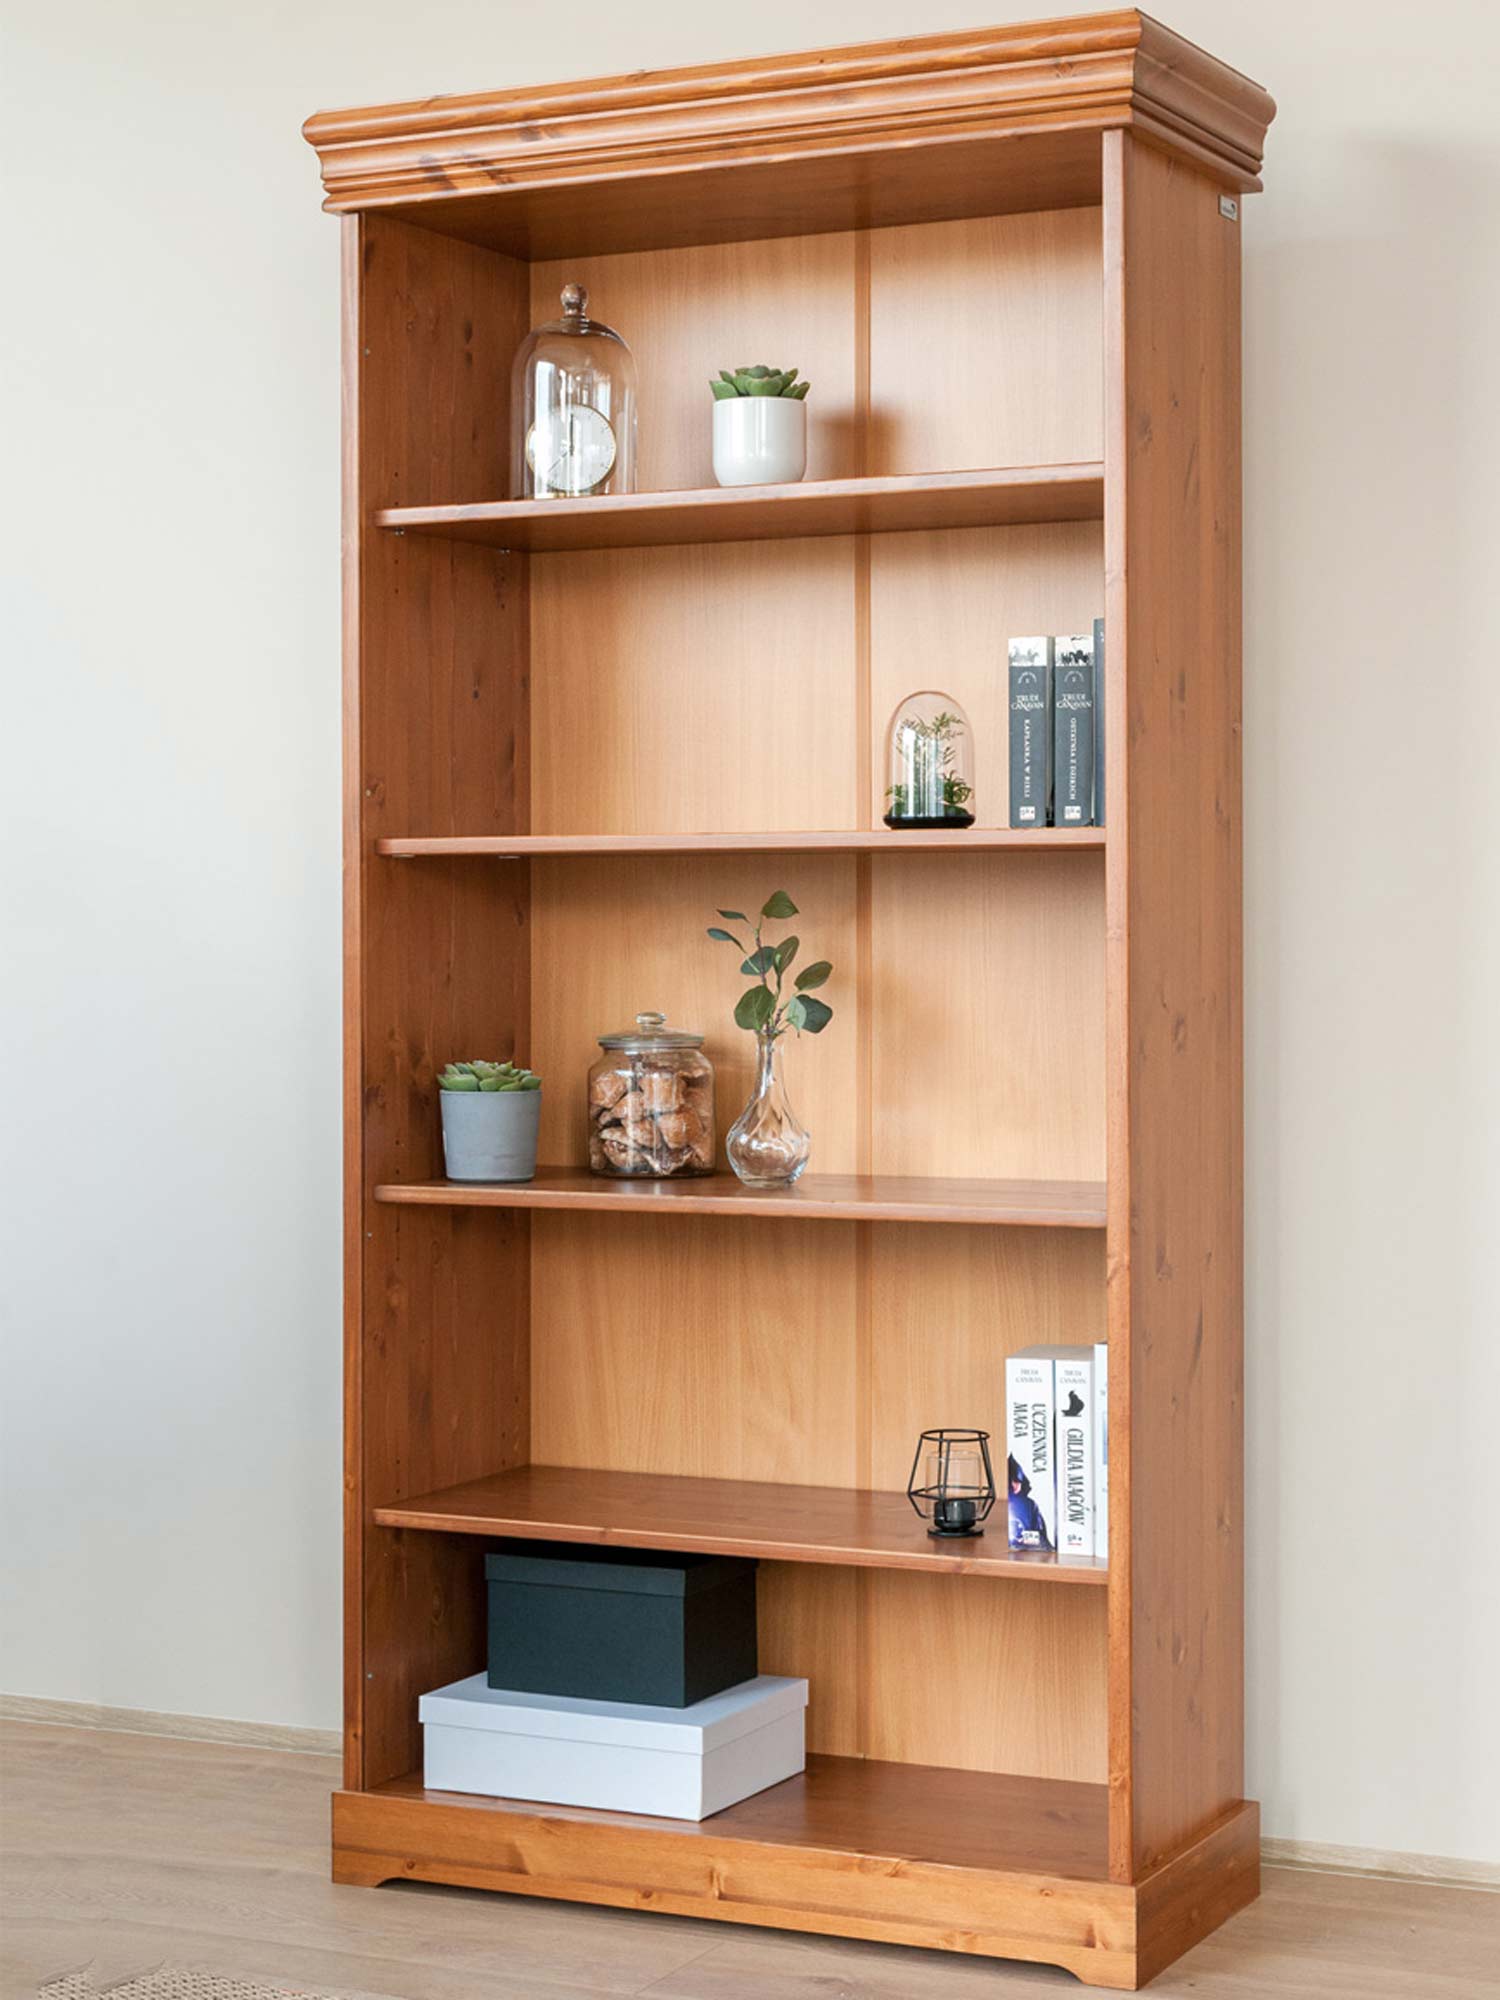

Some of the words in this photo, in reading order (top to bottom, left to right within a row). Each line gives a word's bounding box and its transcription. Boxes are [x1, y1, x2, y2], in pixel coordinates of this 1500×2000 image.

[1013, 1402, 1029, 1438] MAGA
[1031, 1403, 1047, 1473] UCZENNICA
[1067, 1428, 1085, 1471] GILDIA
[1067, 1474, 1090, 1525] MAGÓW
